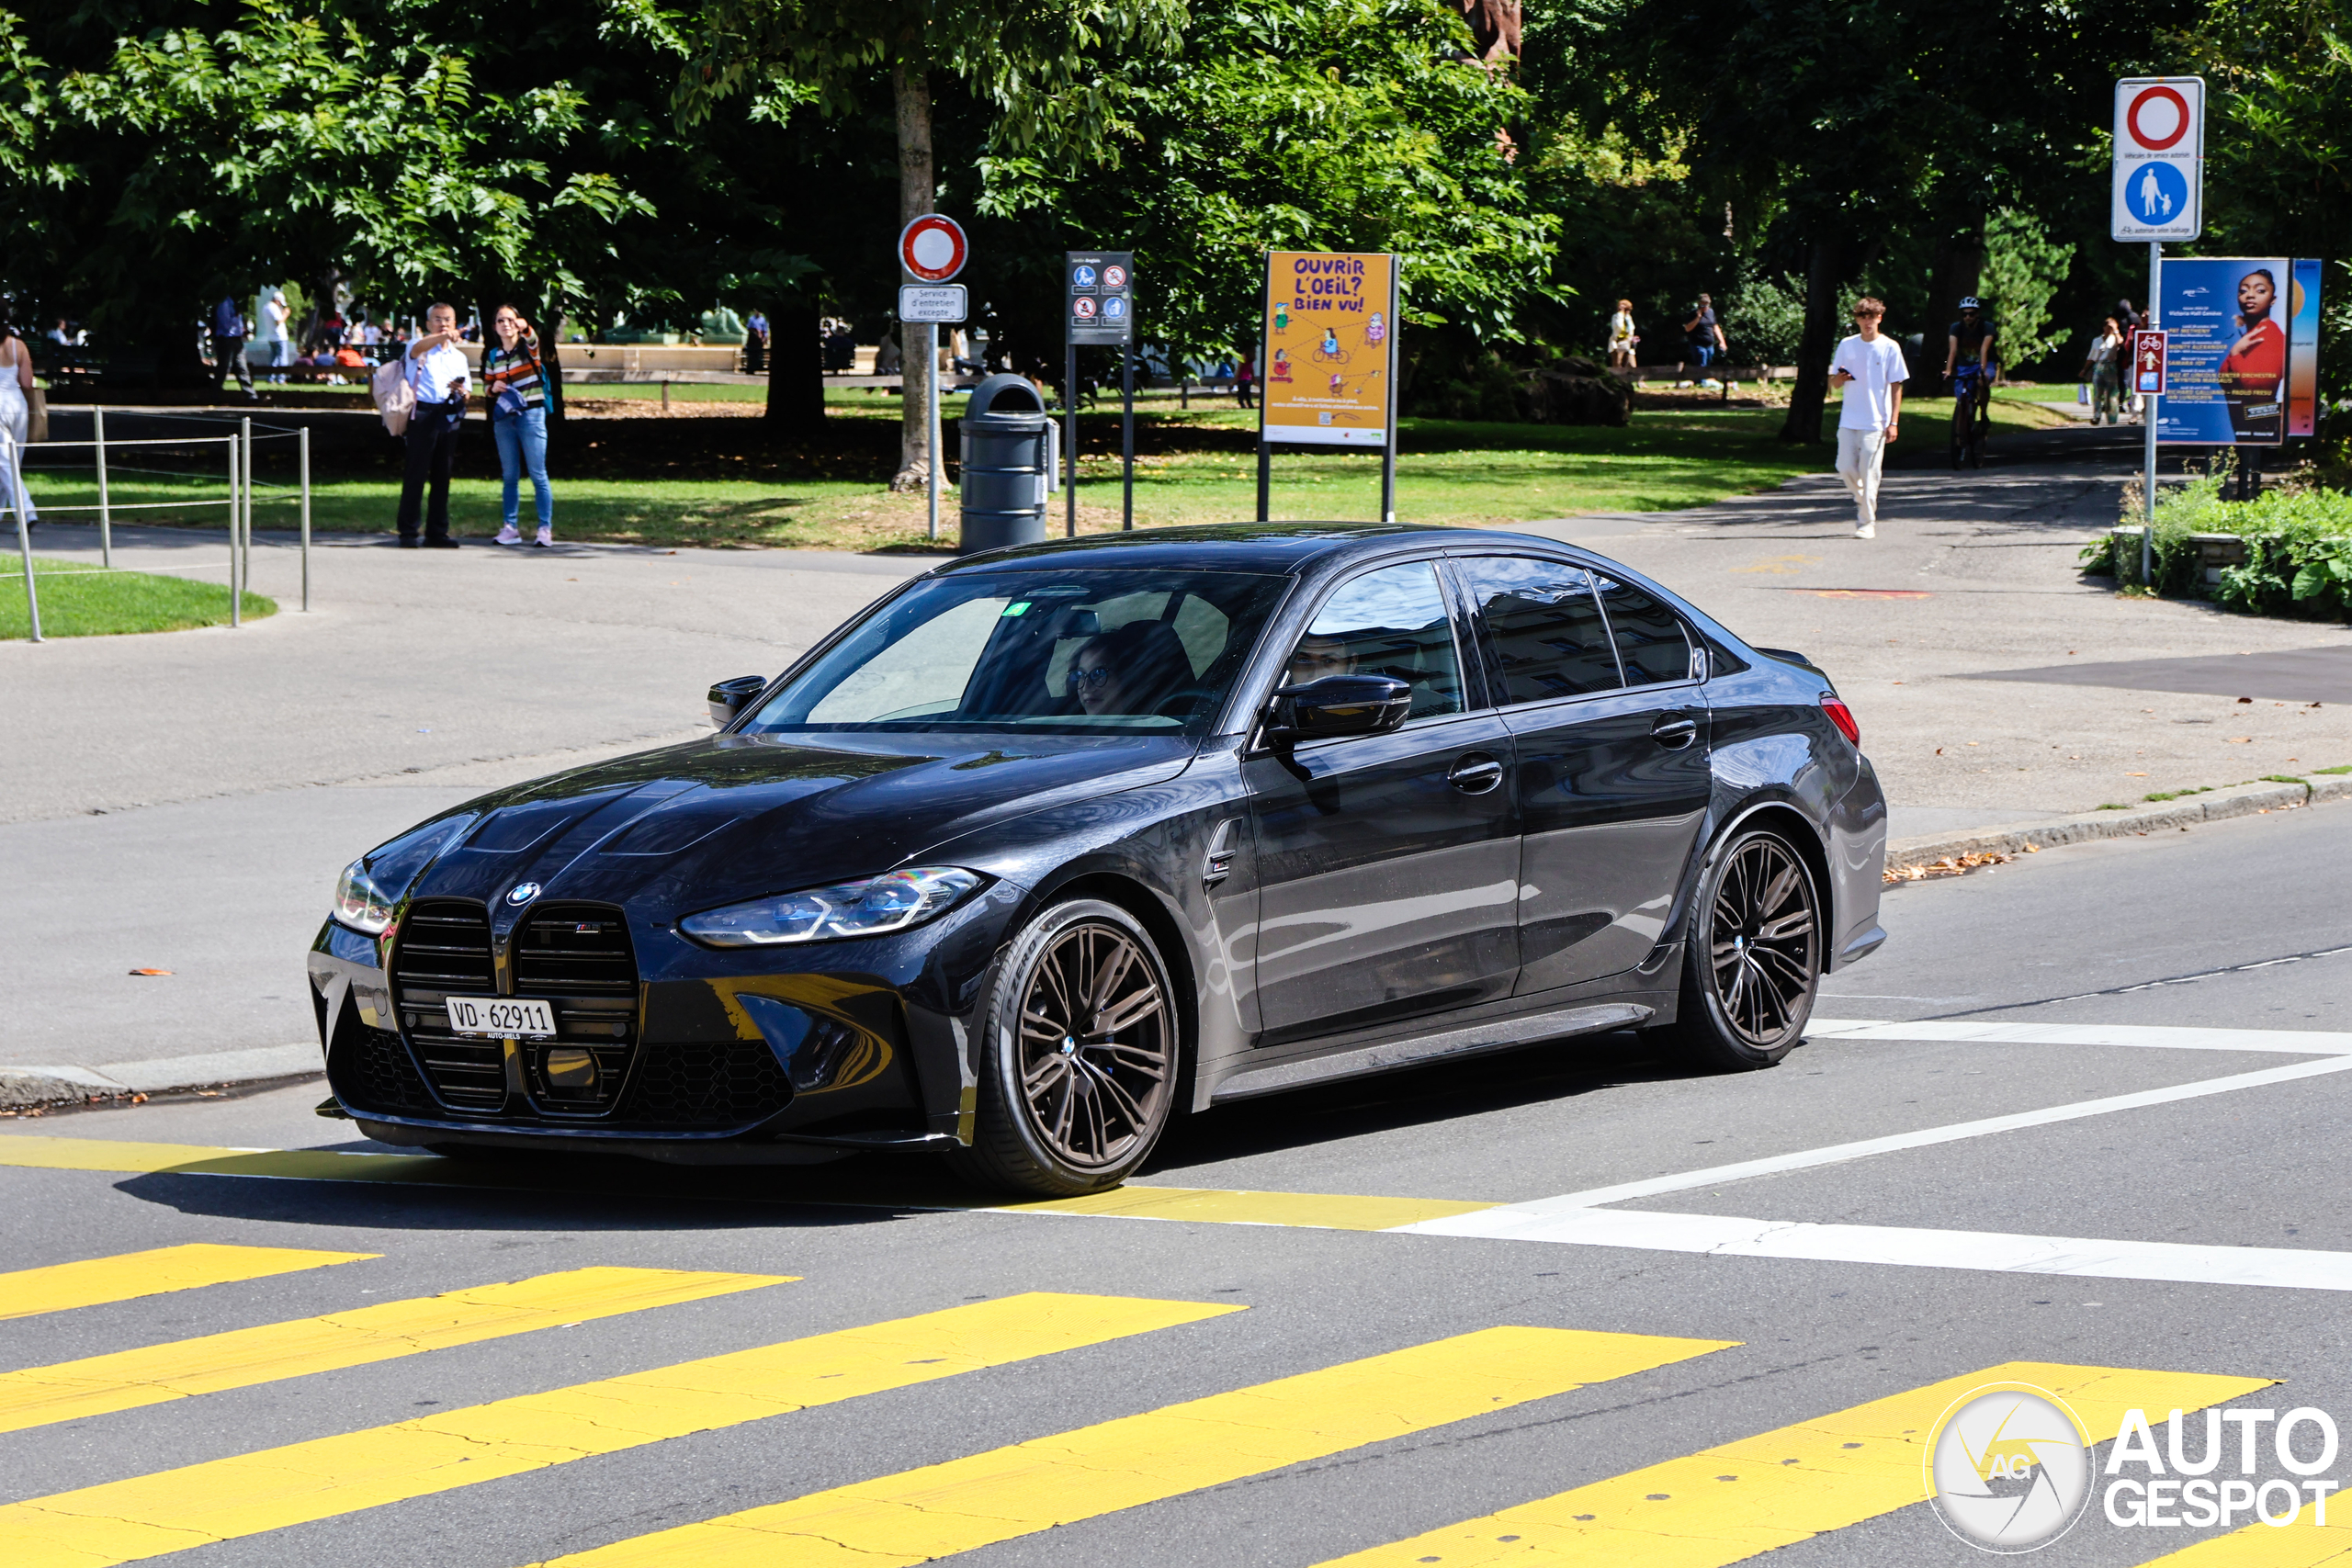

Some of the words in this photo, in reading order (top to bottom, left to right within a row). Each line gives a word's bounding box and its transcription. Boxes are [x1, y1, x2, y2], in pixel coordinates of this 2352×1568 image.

[919, 289, 948, 298] Service
[911, 299, 956, 307] d'entretien
[487, 1032, 521, 1040] AUTO-MELS
